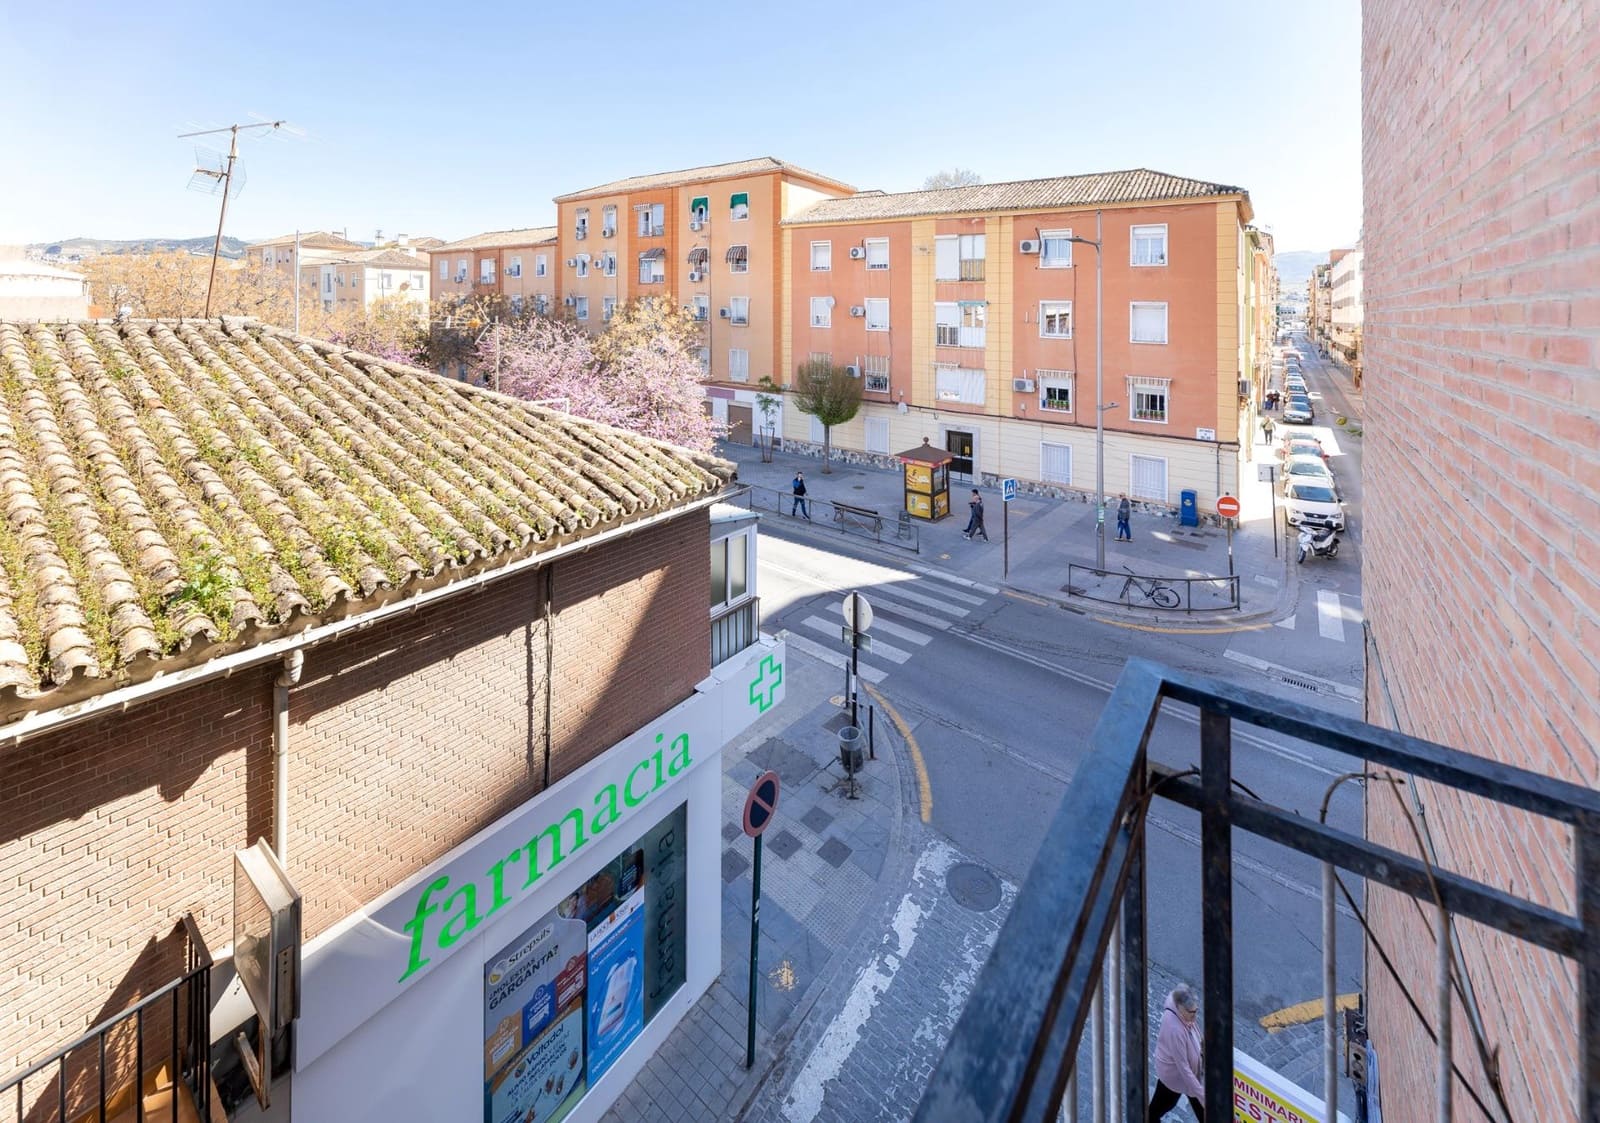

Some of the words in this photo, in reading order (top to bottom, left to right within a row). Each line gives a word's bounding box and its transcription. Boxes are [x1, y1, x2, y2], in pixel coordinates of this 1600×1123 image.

[399, 732, 693, 984] farmacia
[508, 927, 551, 966] Strepsils
[489, 944, 559, 1010] GARGANTA?
[526, 1023, 564, 1065] Voltadol
[1234, 1077, 1303, 1123] MINIMAR
